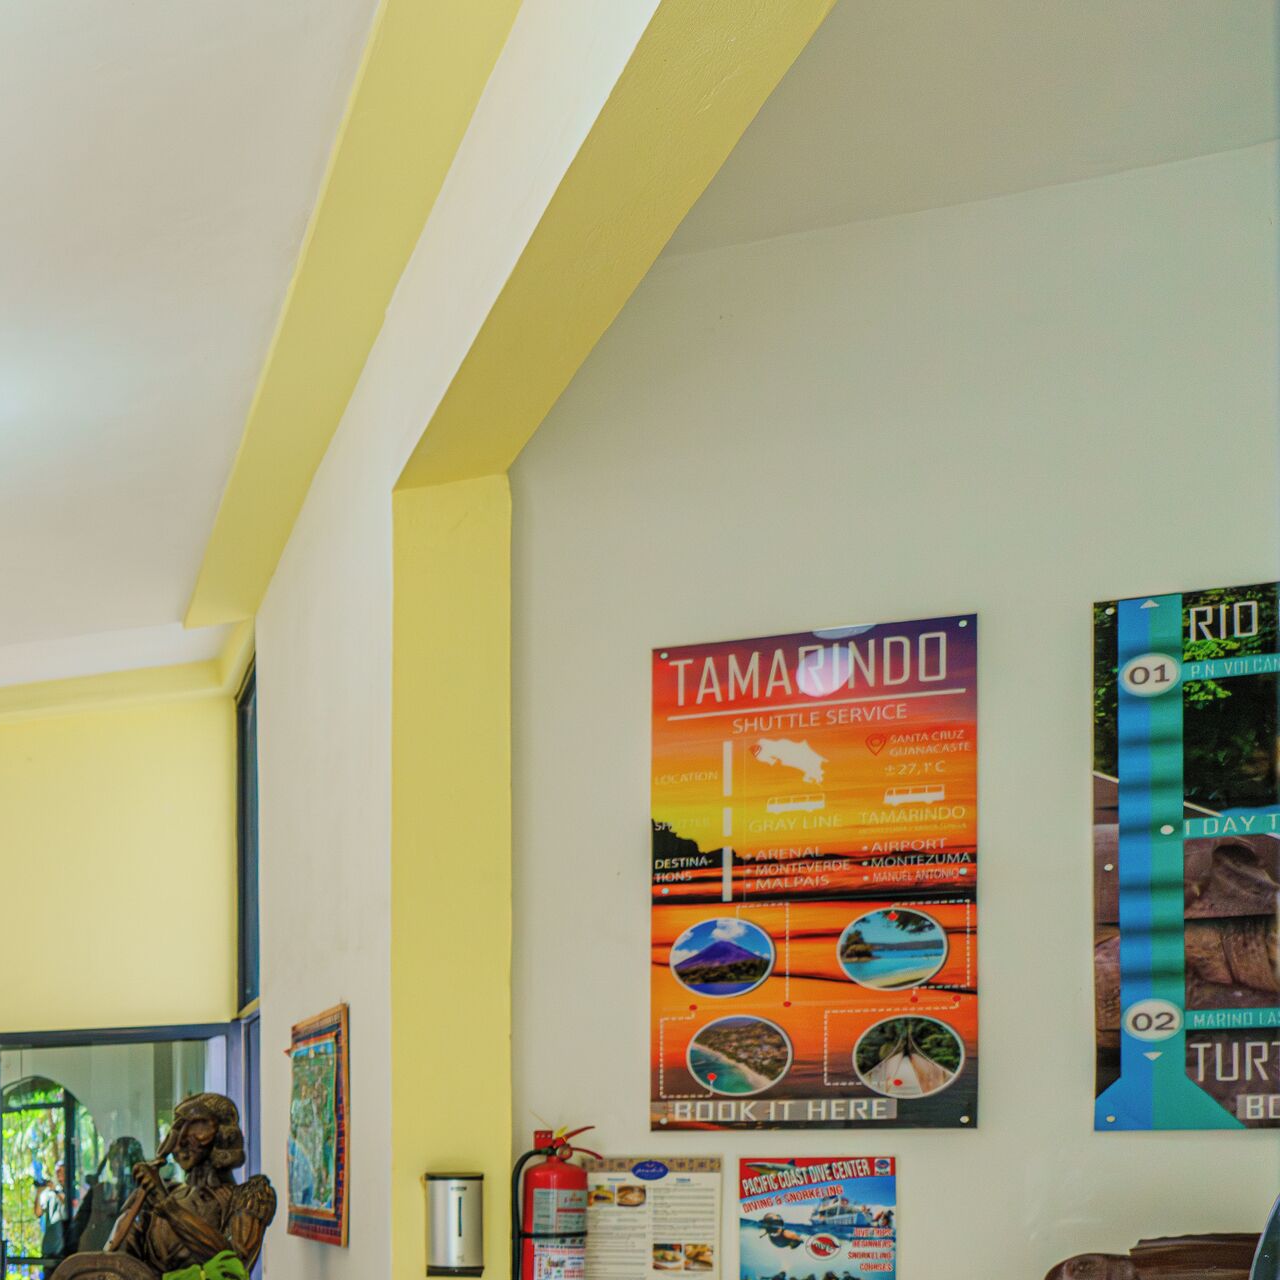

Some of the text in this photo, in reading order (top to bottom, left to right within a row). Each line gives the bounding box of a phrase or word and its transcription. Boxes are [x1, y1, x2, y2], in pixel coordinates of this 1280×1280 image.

[1190, 600, 1258, 642] RIO
[668, 631, 947, 706] TAMARINDO
[1129, 664, 1170, 685] 01
[732, 703, 908, 734] SHUTTLE SERVICE
[890, 729, 965, 744] SANTA CRUZ
[889, 742, 972, 757] GUANACASTE
[655, 770, 719, 785] LOCATION
[748, 818, 797, 833] GRAY
[802, 813, 841, 830] LINE
[859, 805, 966, 825] TAMARINDO
[1203, 815, 1255, 835] DAY
[756, 846, 824, 861] ARENAL
[871, 837, 947, 853] AIRPORT
[655, 856, 713, 870] DESTINA-
[755, 859, 850, 876] MONTEVERDE
[871, 852, 971, 868] MONTEZUMA
[655, 871, 692, 883] TIONS
[756, 875, 830, 890] MALPAIS
[1132, 1012, 1175, 1031] 02
[1193, 1011, 1280, 1028] MARINO LA
[674, 1099, 888, 1121] BOOK IT HERE
[742, 1159, 871, 1197] PACIFIC COAST DIVE CENTER
[742, 1197, 774, 1213] DIVING
[784, 1184, 844, 1203] SNORKELING
